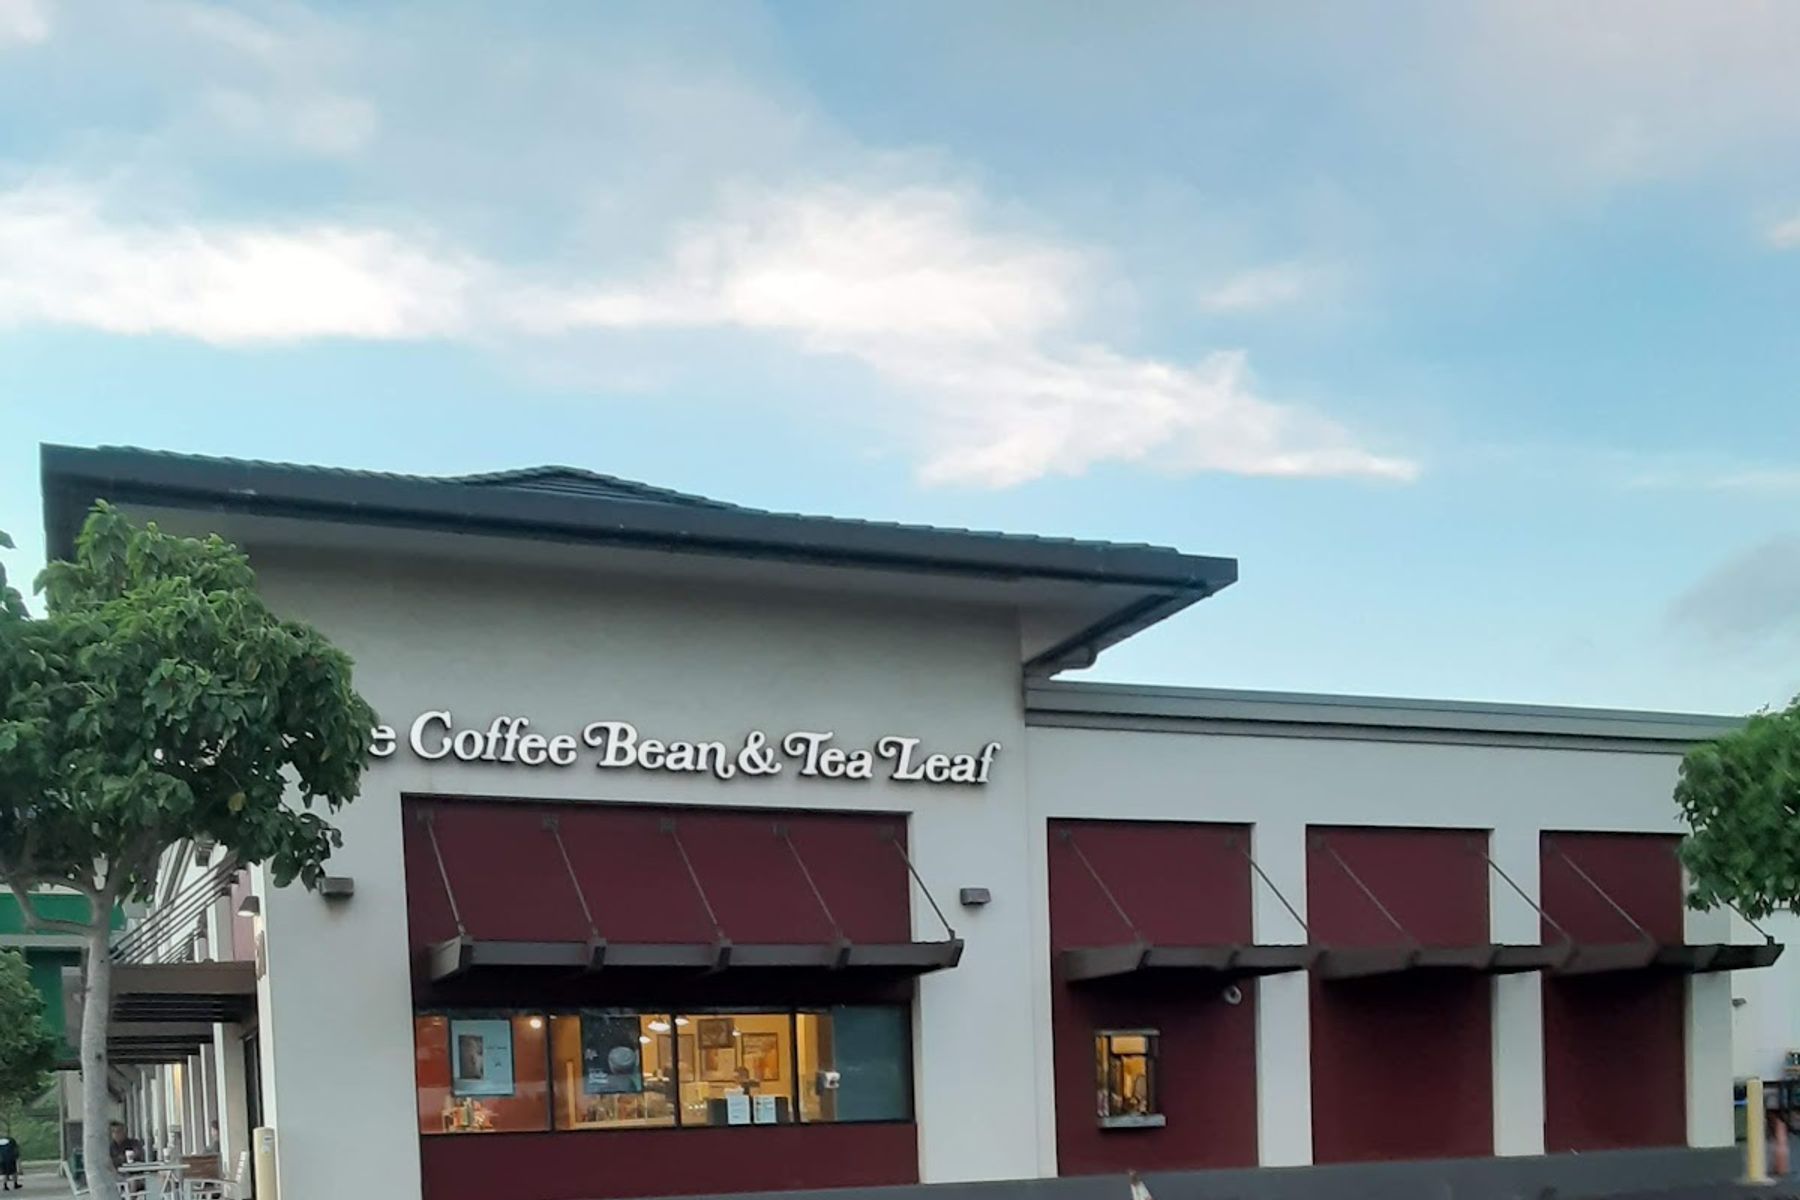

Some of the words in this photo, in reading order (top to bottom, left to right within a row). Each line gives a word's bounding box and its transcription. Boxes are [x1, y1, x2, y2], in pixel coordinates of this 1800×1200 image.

[410, 711, 577, 765] Coffee
[583, 721, 735, 779] Bean
[738, 731, 782, 775] &
[784, 732, 873, 778] Tea
[878, 736, 1001, 783] Leaf
